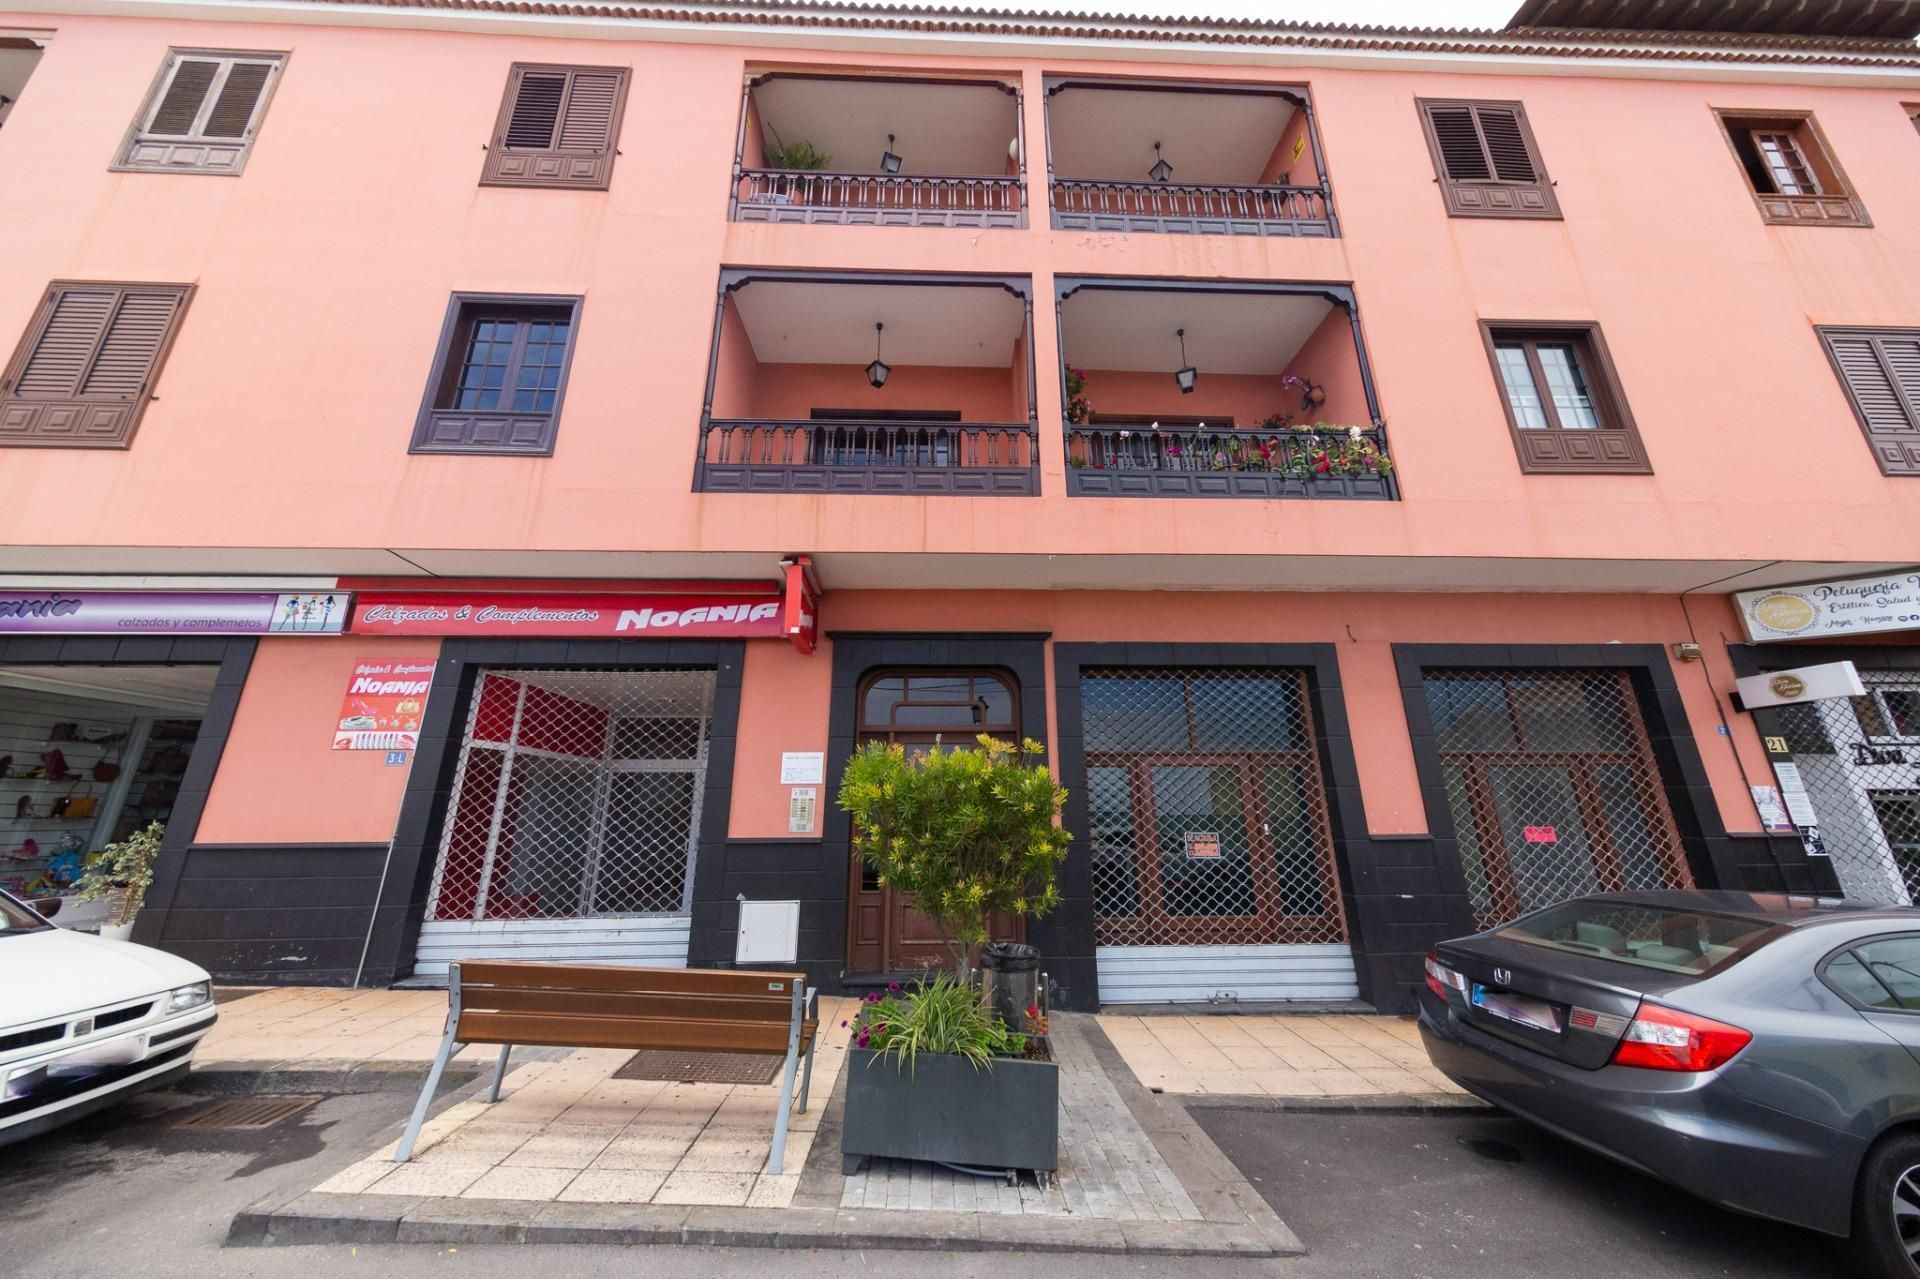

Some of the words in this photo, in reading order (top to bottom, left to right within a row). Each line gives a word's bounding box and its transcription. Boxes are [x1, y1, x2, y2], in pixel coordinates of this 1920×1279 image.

[1876, 596, 1912, 608] Salud
[363, 605, 449, 623] Calzados
[455, 605, 472, 619] &
[475, 605, 599, 623] Complementos
[118, 618, 170, 627] calzados
[173, 619, 180, 628] y
[1767, 739, 1786, 751] 21
